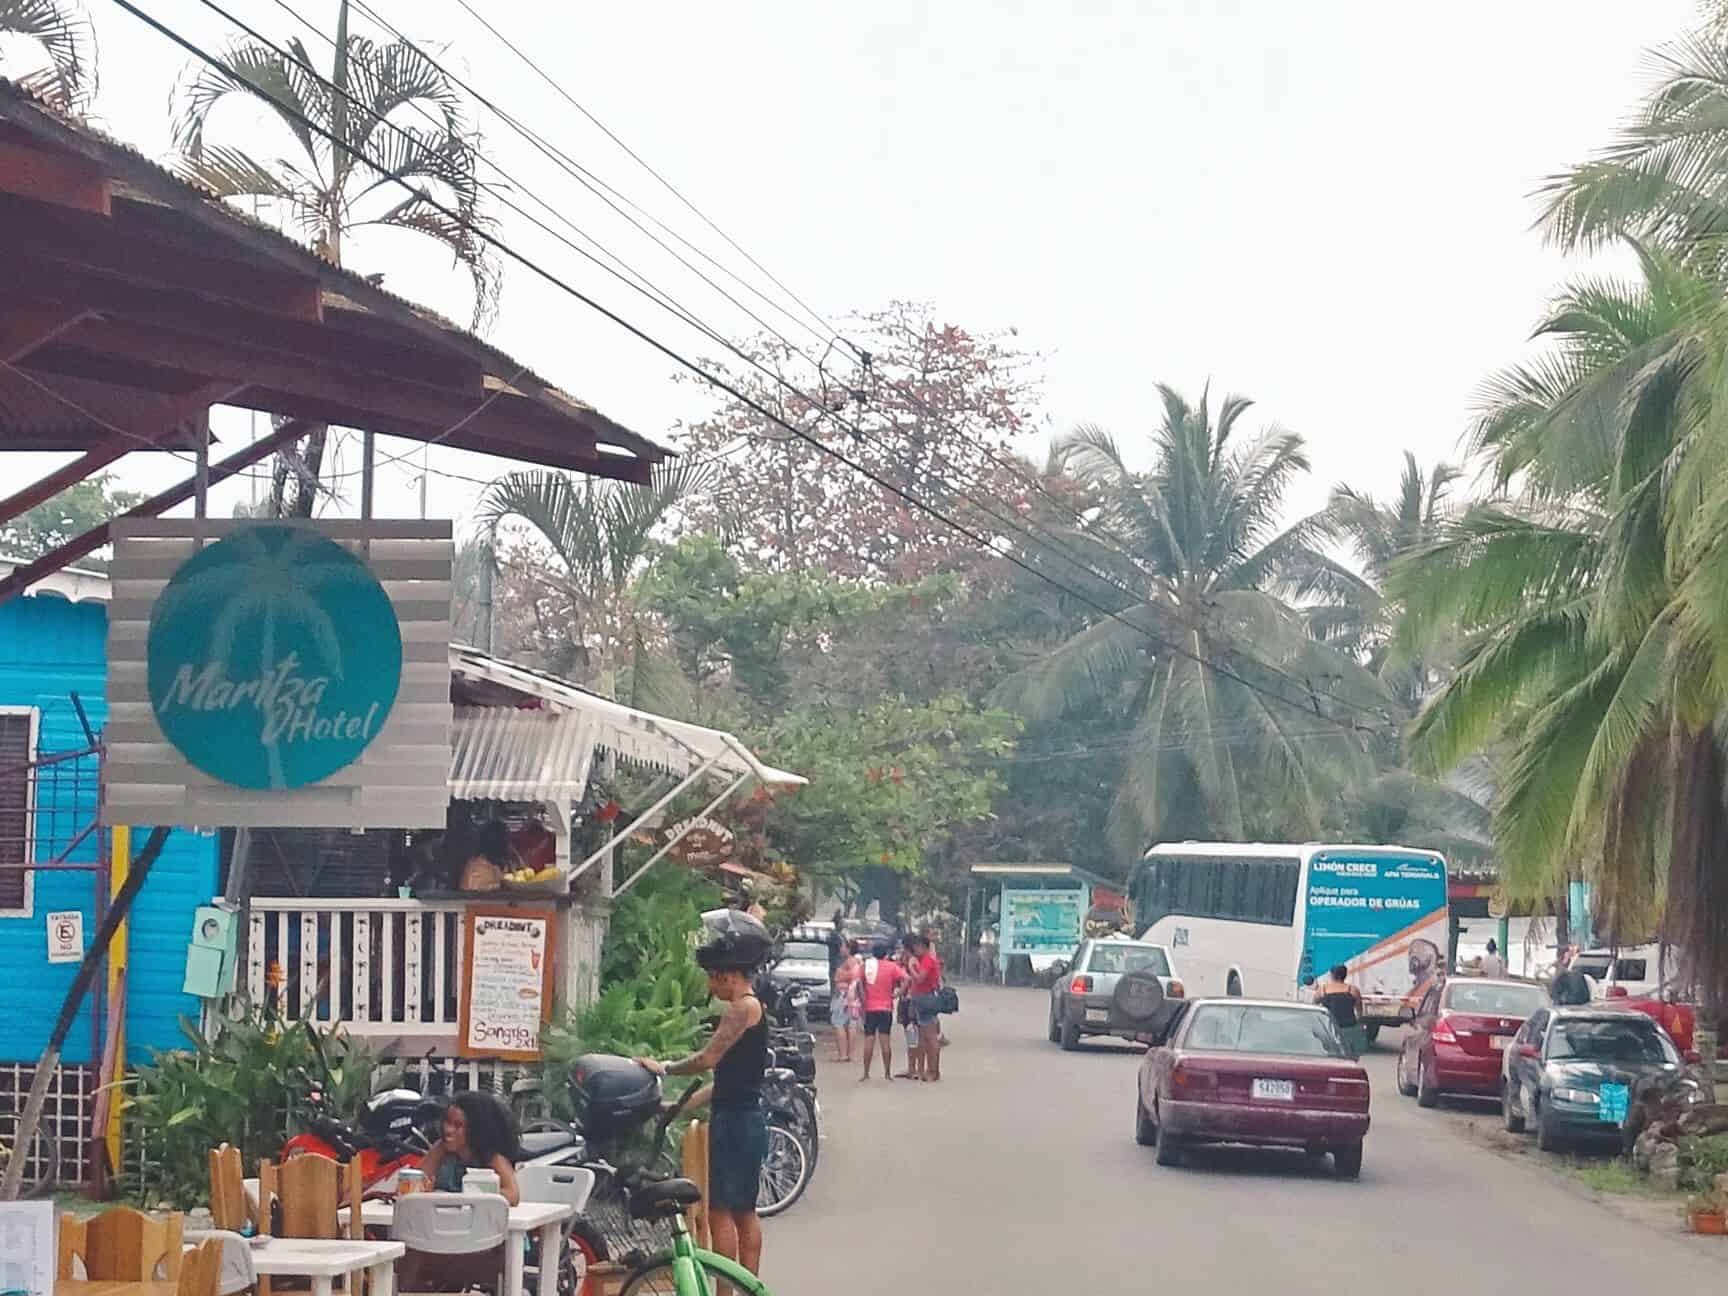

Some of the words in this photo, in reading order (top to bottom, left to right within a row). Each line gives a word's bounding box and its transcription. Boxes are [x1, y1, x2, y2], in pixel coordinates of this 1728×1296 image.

[159, 650, 328, 744] Maritza
[287, 702, 380, 744] Hotel
[1310, 896, 1367, 907] OPERADOR
[1369, 898, 1383, 908] DE
